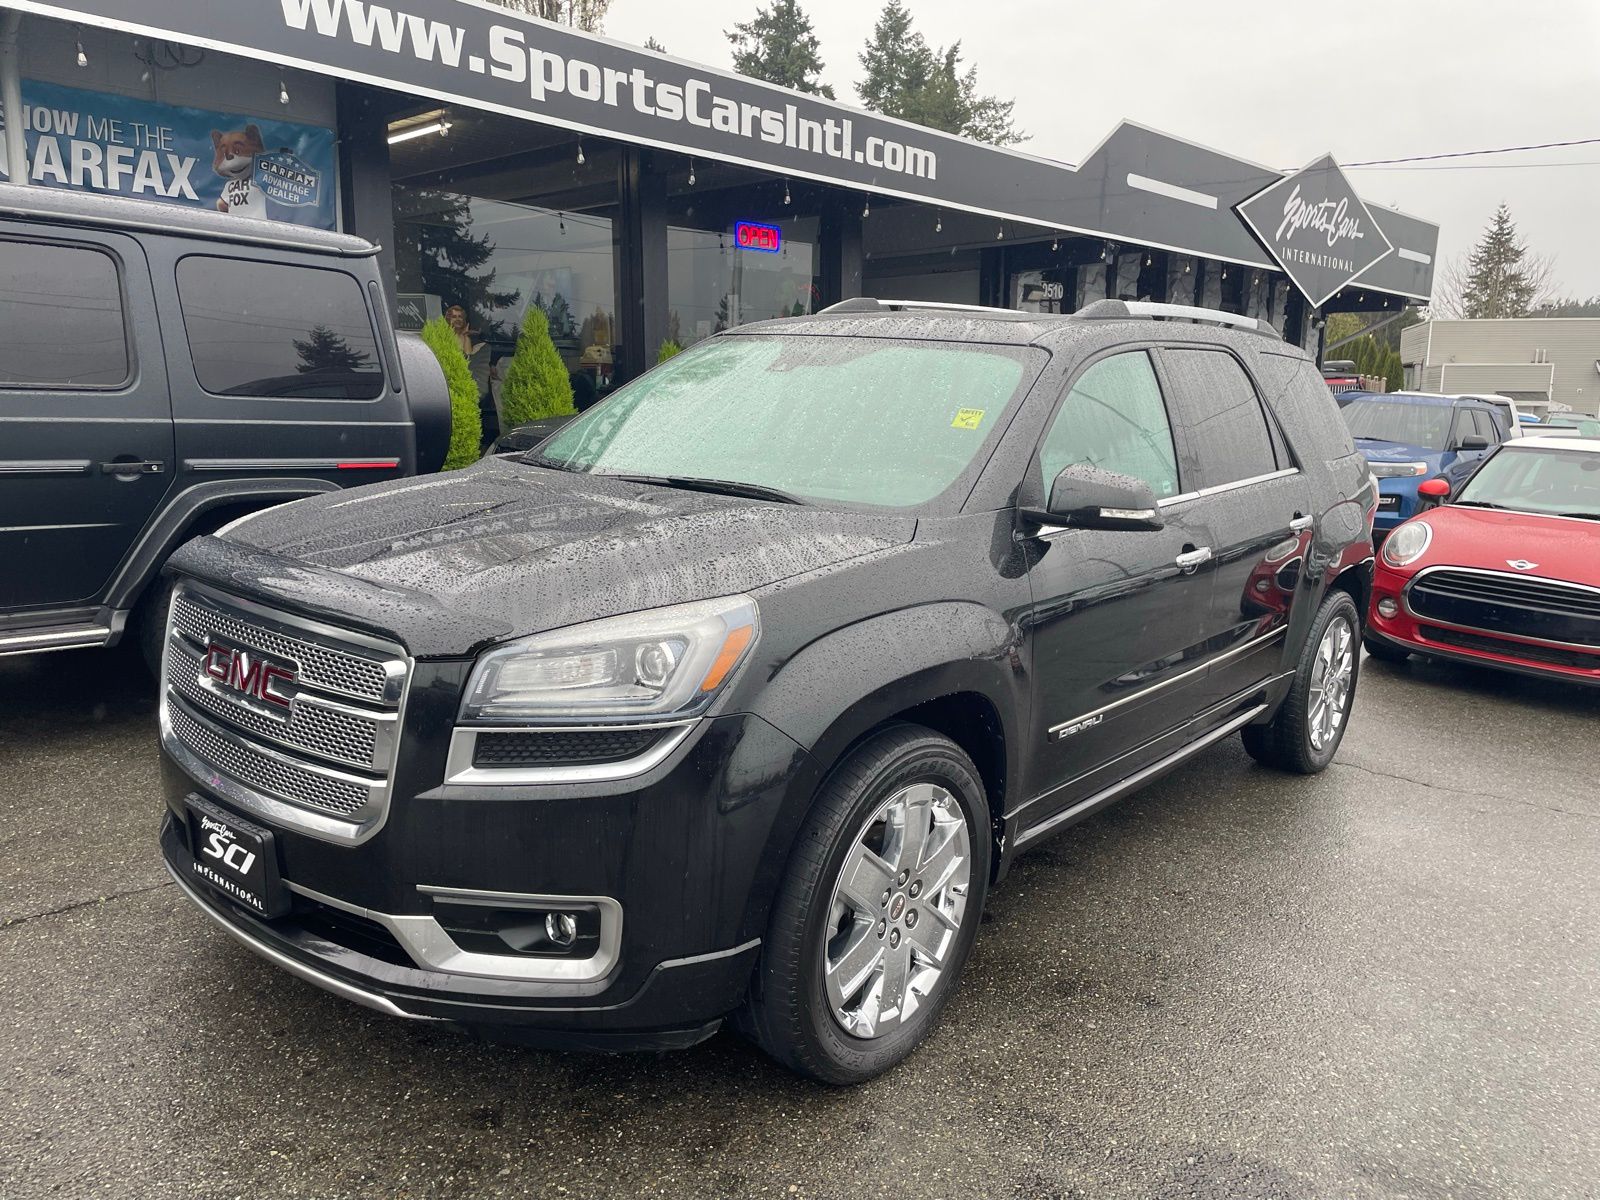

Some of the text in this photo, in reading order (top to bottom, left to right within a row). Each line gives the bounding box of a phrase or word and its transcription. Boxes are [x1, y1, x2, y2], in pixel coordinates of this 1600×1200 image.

[87, 115, 124, 144] ME
[129, 122, 173, 151] THE
[228, 179, 249, 193] CAR
[260, 160, 315, 187] CARFAX
[262, 174, 310, 196] ADVANTAGE
[228, 192, 249, 206] FOX
[267, 186, 299, 203] DEALER
[1276, 184, 1364, 247] Sports Cars
[738, 224, 778, 249] OPEN
[1282, 247, 1353, 272] INTERNATIONAL
[205, 641, 296, 708] GMC
[1058, 714, 1104, 739] DENALI
[203, 832, 256, 875] SCI
[193, 862, 264, 910] INTERNATIONAL
